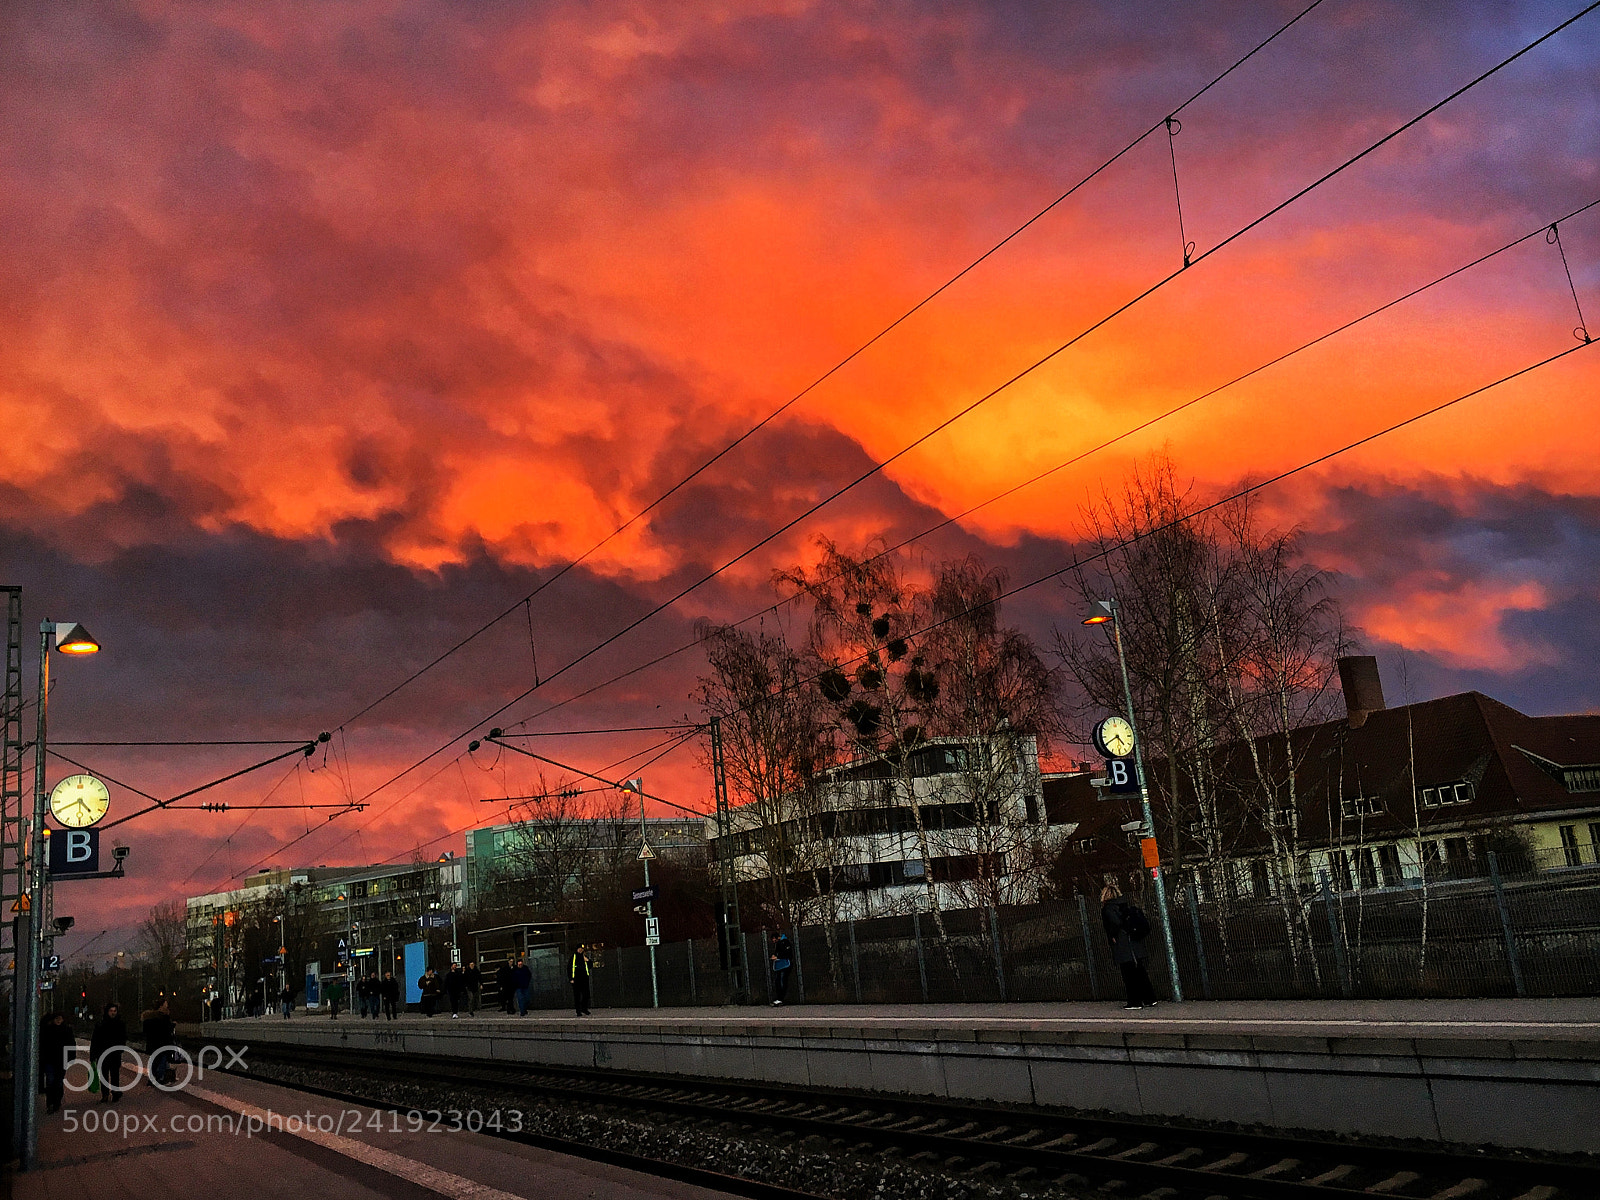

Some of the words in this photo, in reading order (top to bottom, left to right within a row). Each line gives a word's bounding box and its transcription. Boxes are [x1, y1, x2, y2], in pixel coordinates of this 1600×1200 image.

[1111, 760, 1128, 785] B
[66, 830, 92, 863] B
[418, 915, 423, 927] 1
[647, 919, 657, 936] H
[338, 938, 346, 948] A
[49, 955, 58, 968] 2
[452, 950, 460, 963] H
